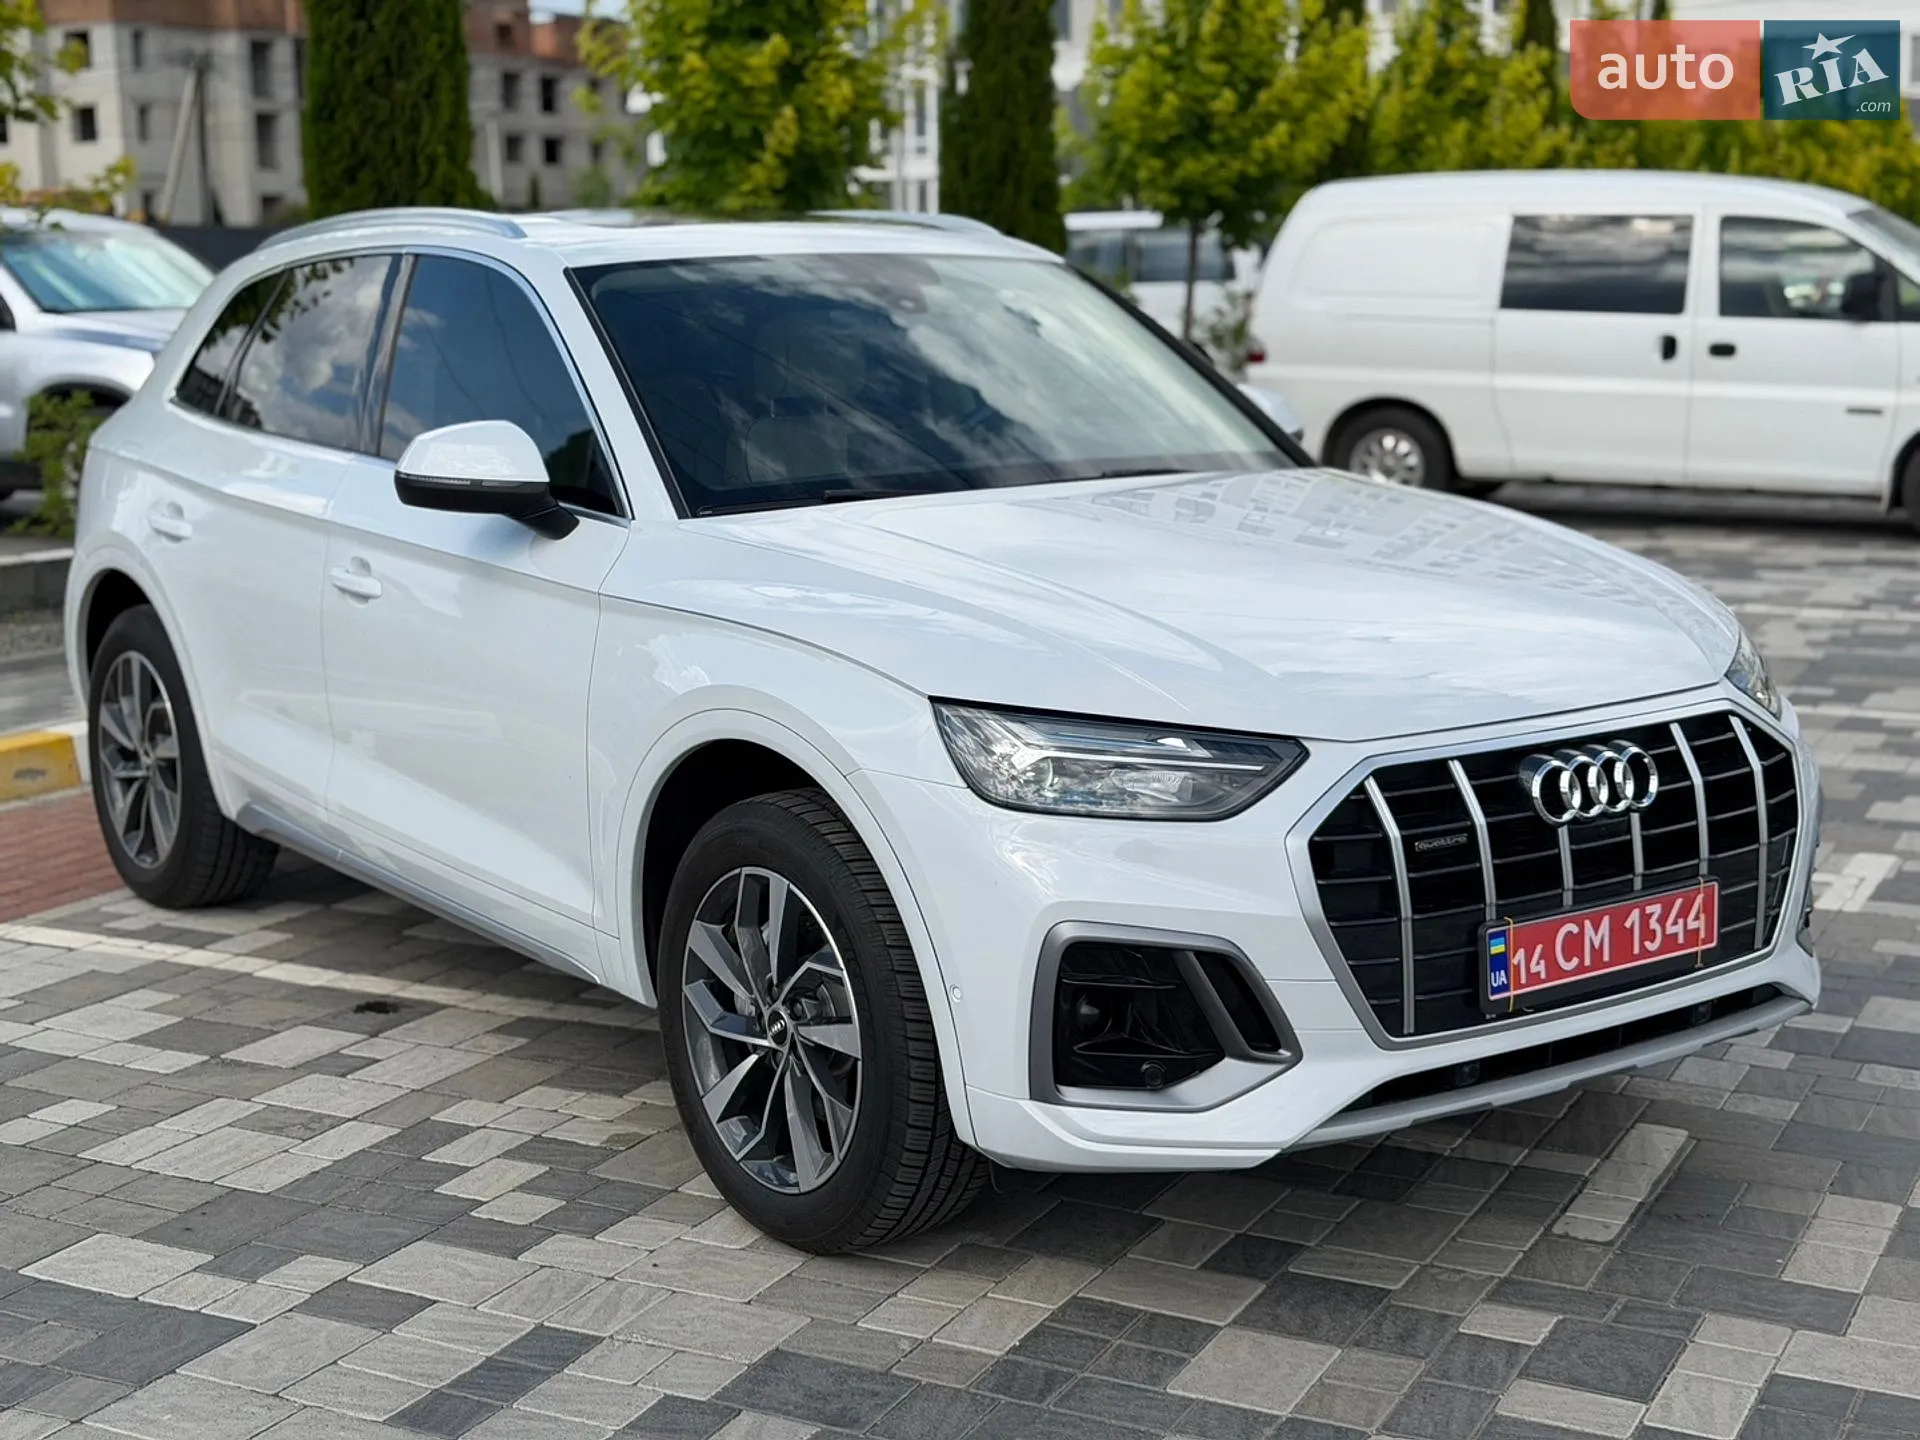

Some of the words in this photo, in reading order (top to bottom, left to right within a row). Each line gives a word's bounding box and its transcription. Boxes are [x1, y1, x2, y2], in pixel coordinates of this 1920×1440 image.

[1512, 944, 1546, 984] 14
[1555, 915, 1610, 971] CM
[1624, 893, 1705, 955] 1344
[1491, 971, 1508, 987] UA
